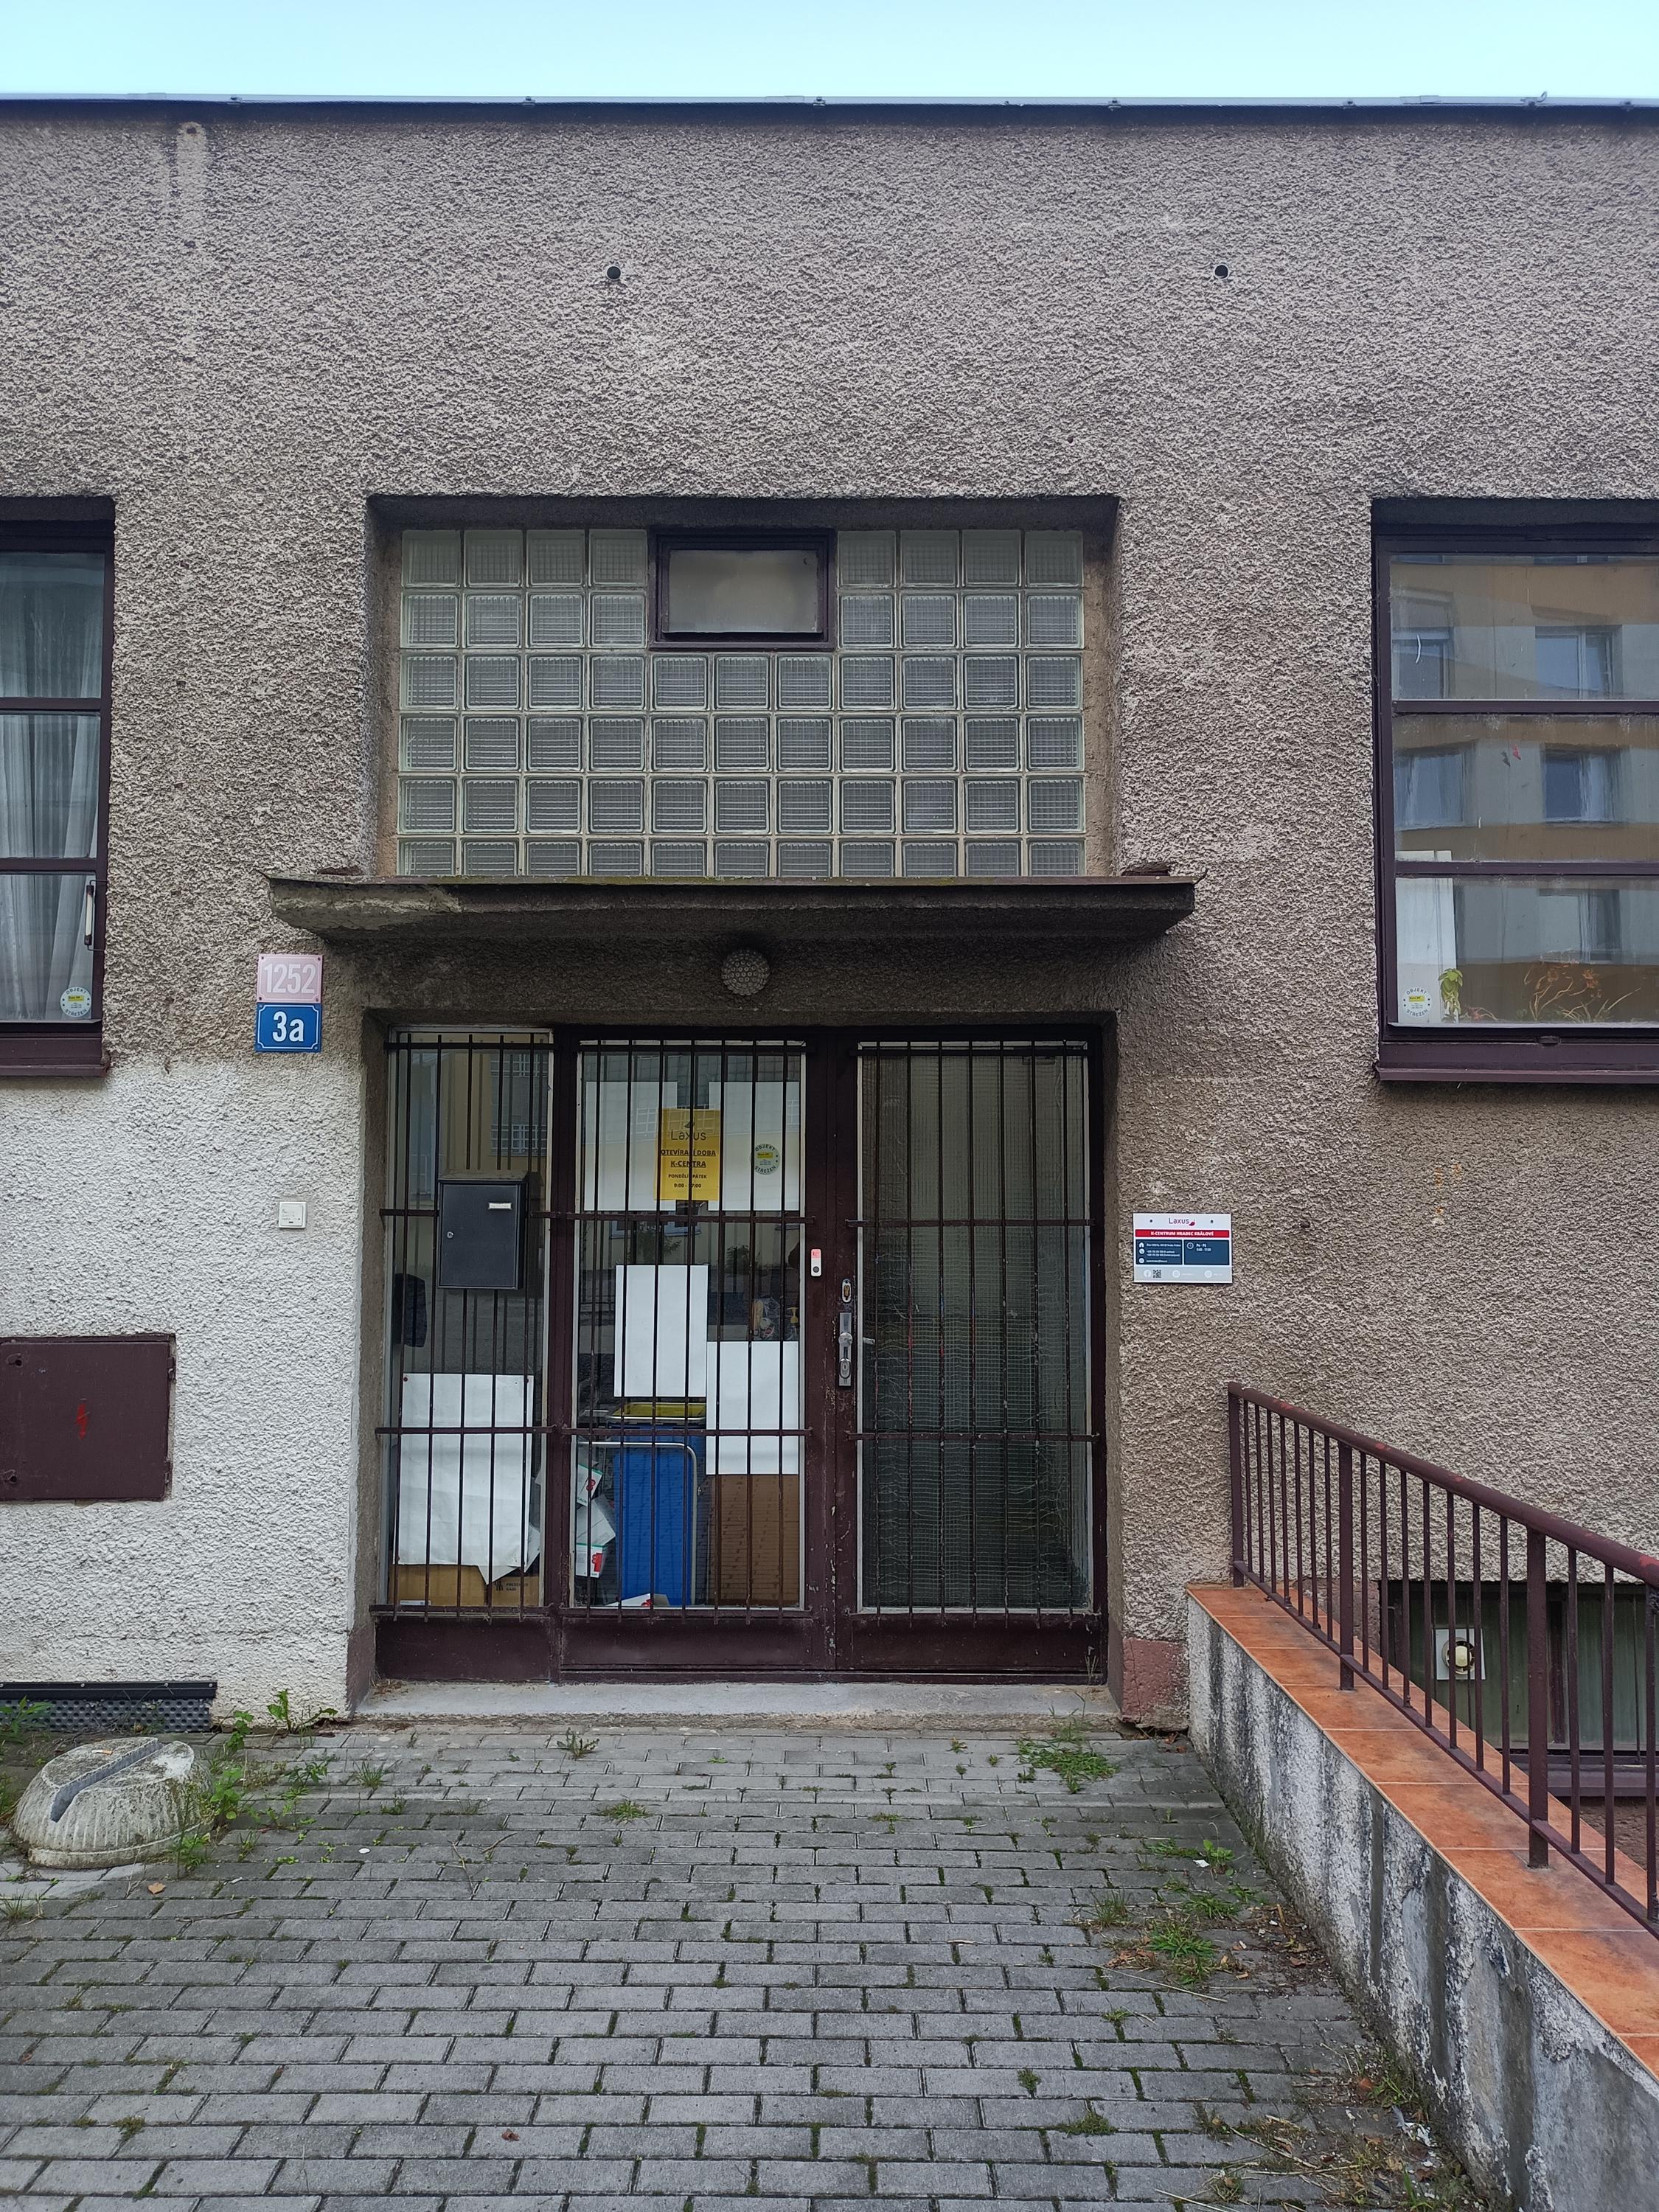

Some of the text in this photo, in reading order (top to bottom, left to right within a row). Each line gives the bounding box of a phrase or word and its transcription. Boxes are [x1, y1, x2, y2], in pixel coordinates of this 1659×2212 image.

[264, 963, 316, 994] 1252
[272, 1011, 305, 1042] 3a
[671, 1129, 707, 1141] Laxus
[661, 1148, 696, 1156] OTEVÍRAÍ
[755, 1144, 776, 1152] OBJEKT
